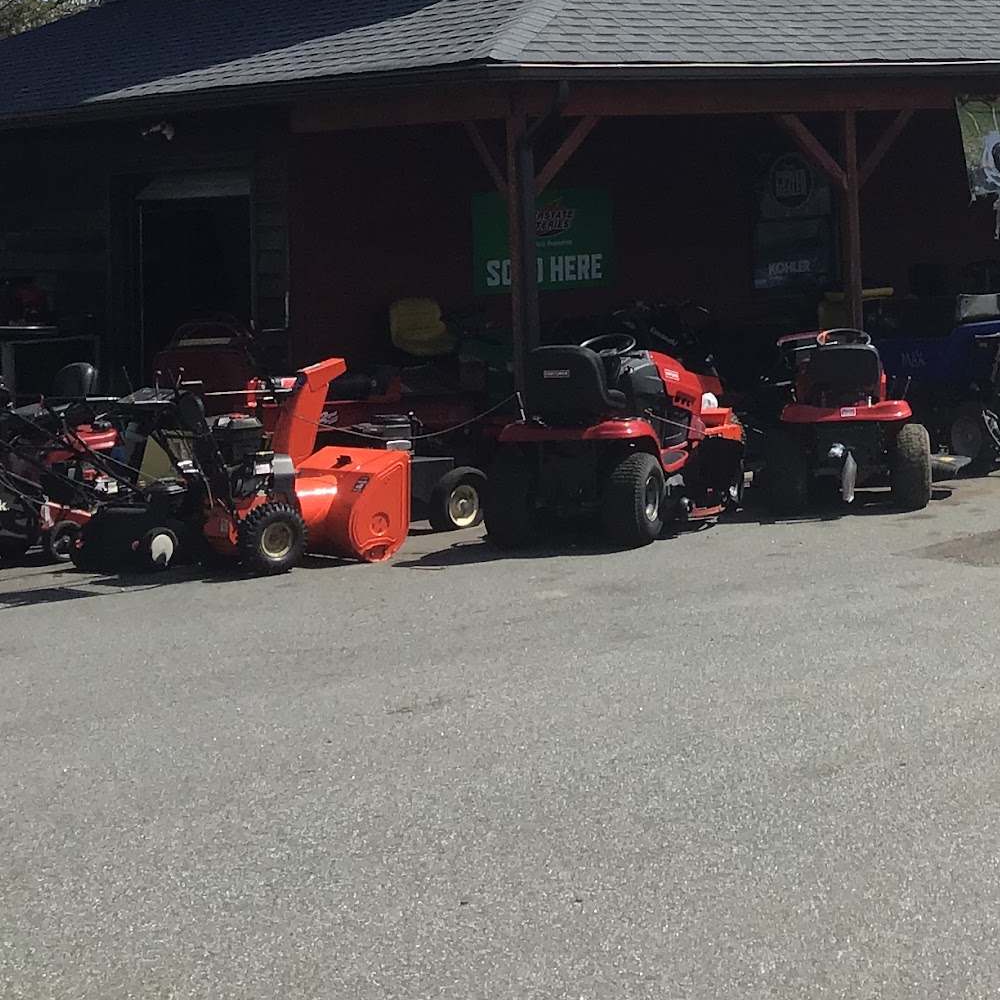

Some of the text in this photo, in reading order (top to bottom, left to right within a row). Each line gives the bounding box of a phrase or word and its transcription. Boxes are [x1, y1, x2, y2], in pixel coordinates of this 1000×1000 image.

[486, 253, 603, 287] SOD HERE
[768, 259, 811, 275] KOHLER
